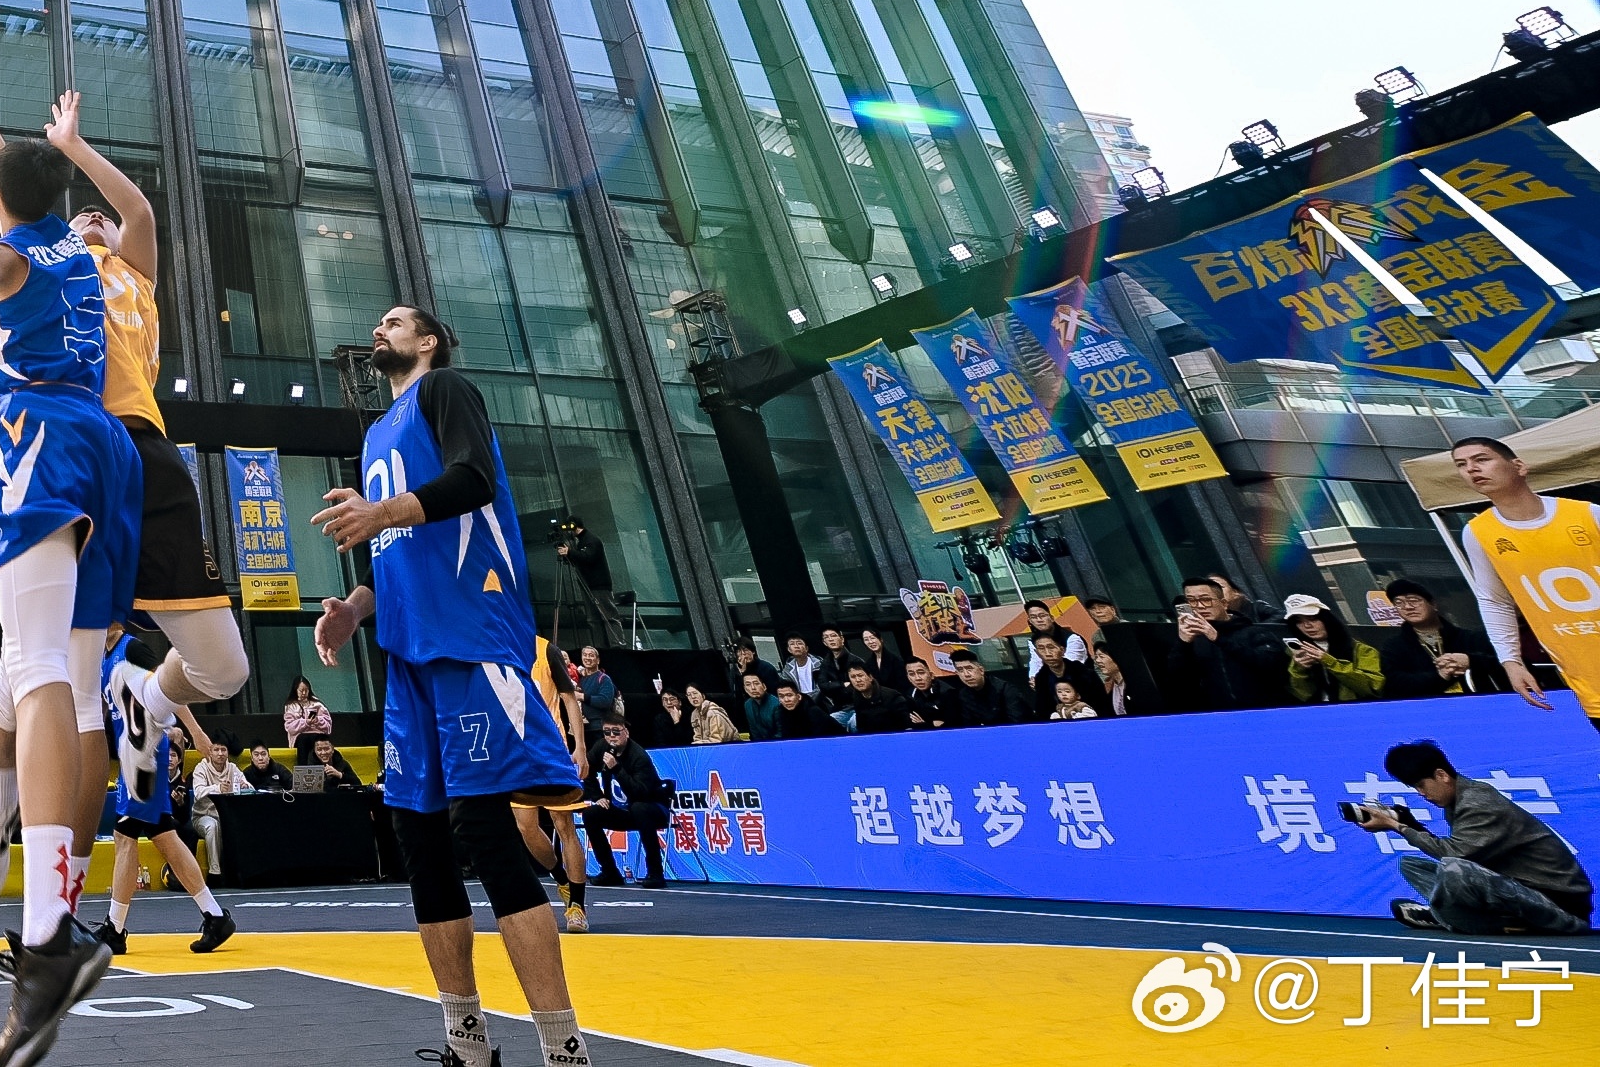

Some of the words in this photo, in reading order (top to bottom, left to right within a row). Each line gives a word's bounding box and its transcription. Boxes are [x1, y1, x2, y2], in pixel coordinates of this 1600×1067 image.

[1067, 340, 1130, 370] 黄金联赛
[965, 372, 1033, 417] 沈阳
[1079, 361, 1151, 397] 2025
[876, 399, 937, 440] 天津
[1097, 389, 1183, 428] 全国总决赛
[897, 432, 951, 465] 天津斗牛
[1007, 435, 1067, 464] 全国总决赛
[914, 457, 966, 485] 全国总决赛
[238, 500, 284, 528] 南京
[246, 553, 289, 569] 全国总决赛
[1520, 566, 1600, 613] 10
[1553, 620, 1600, 637] 长安
[459, 712, 490, 762] 7
[849, 780, 1117, 851] 超越梦想
[449, 1028, 485, 1042] LOTTO
[550, 1052, 588, 1066] LOTTO
